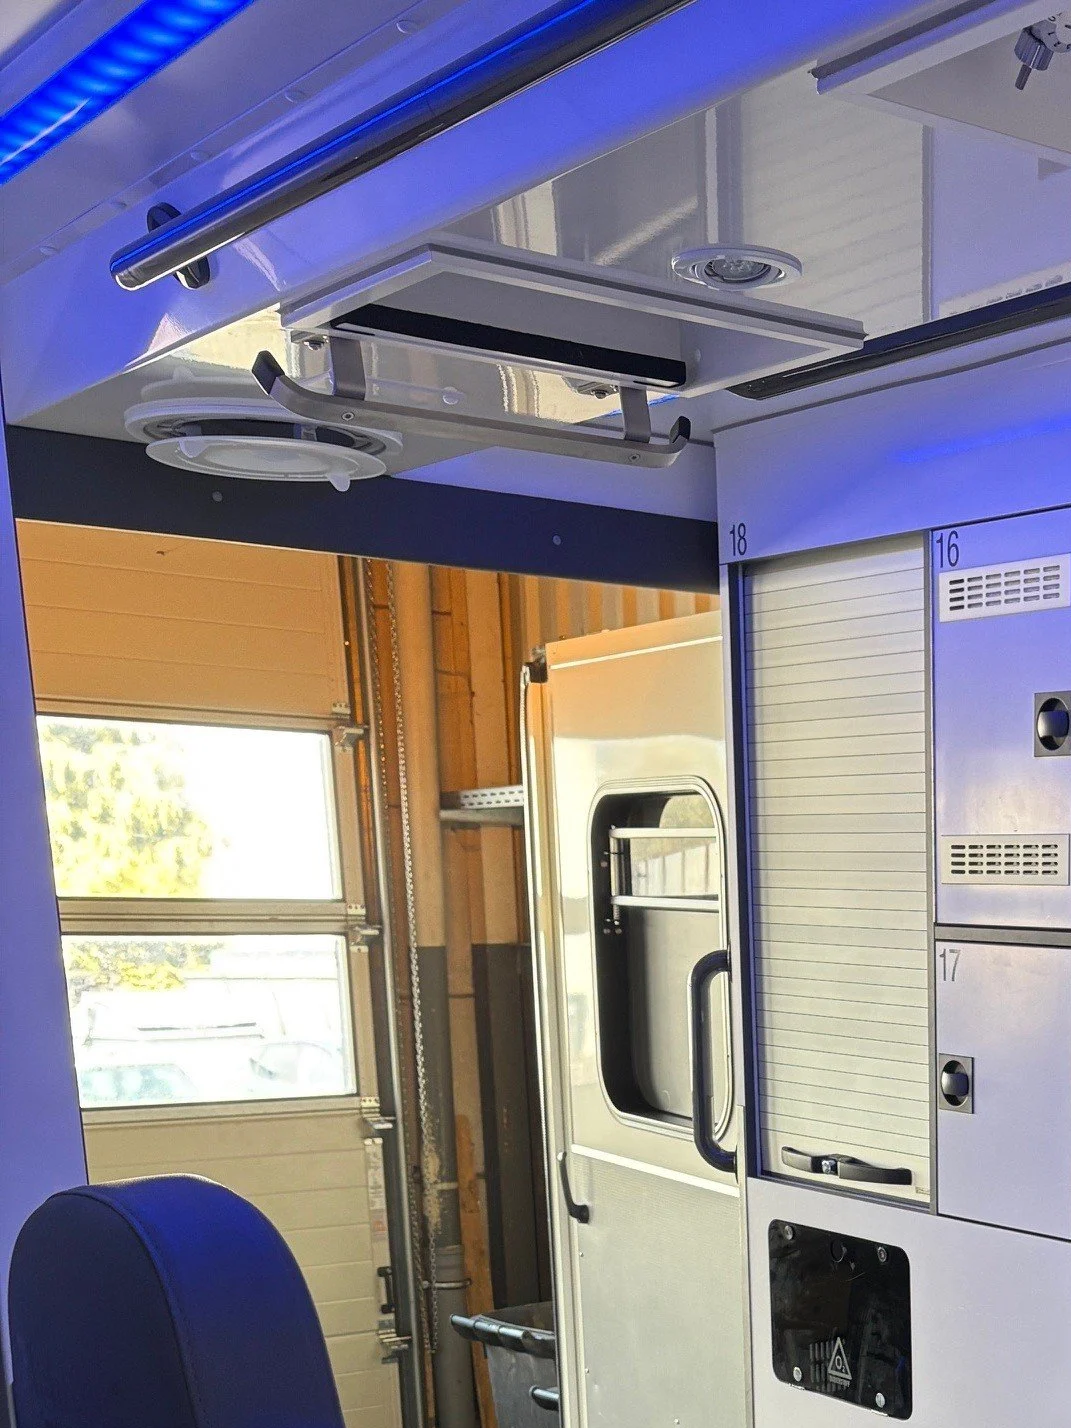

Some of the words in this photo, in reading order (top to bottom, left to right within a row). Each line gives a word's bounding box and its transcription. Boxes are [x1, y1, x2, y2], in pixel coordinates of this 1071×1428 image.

[729, 522, 747, 557] 18
[935, 530, 960, 569] 16
[939, 948, 961, 981] 17
